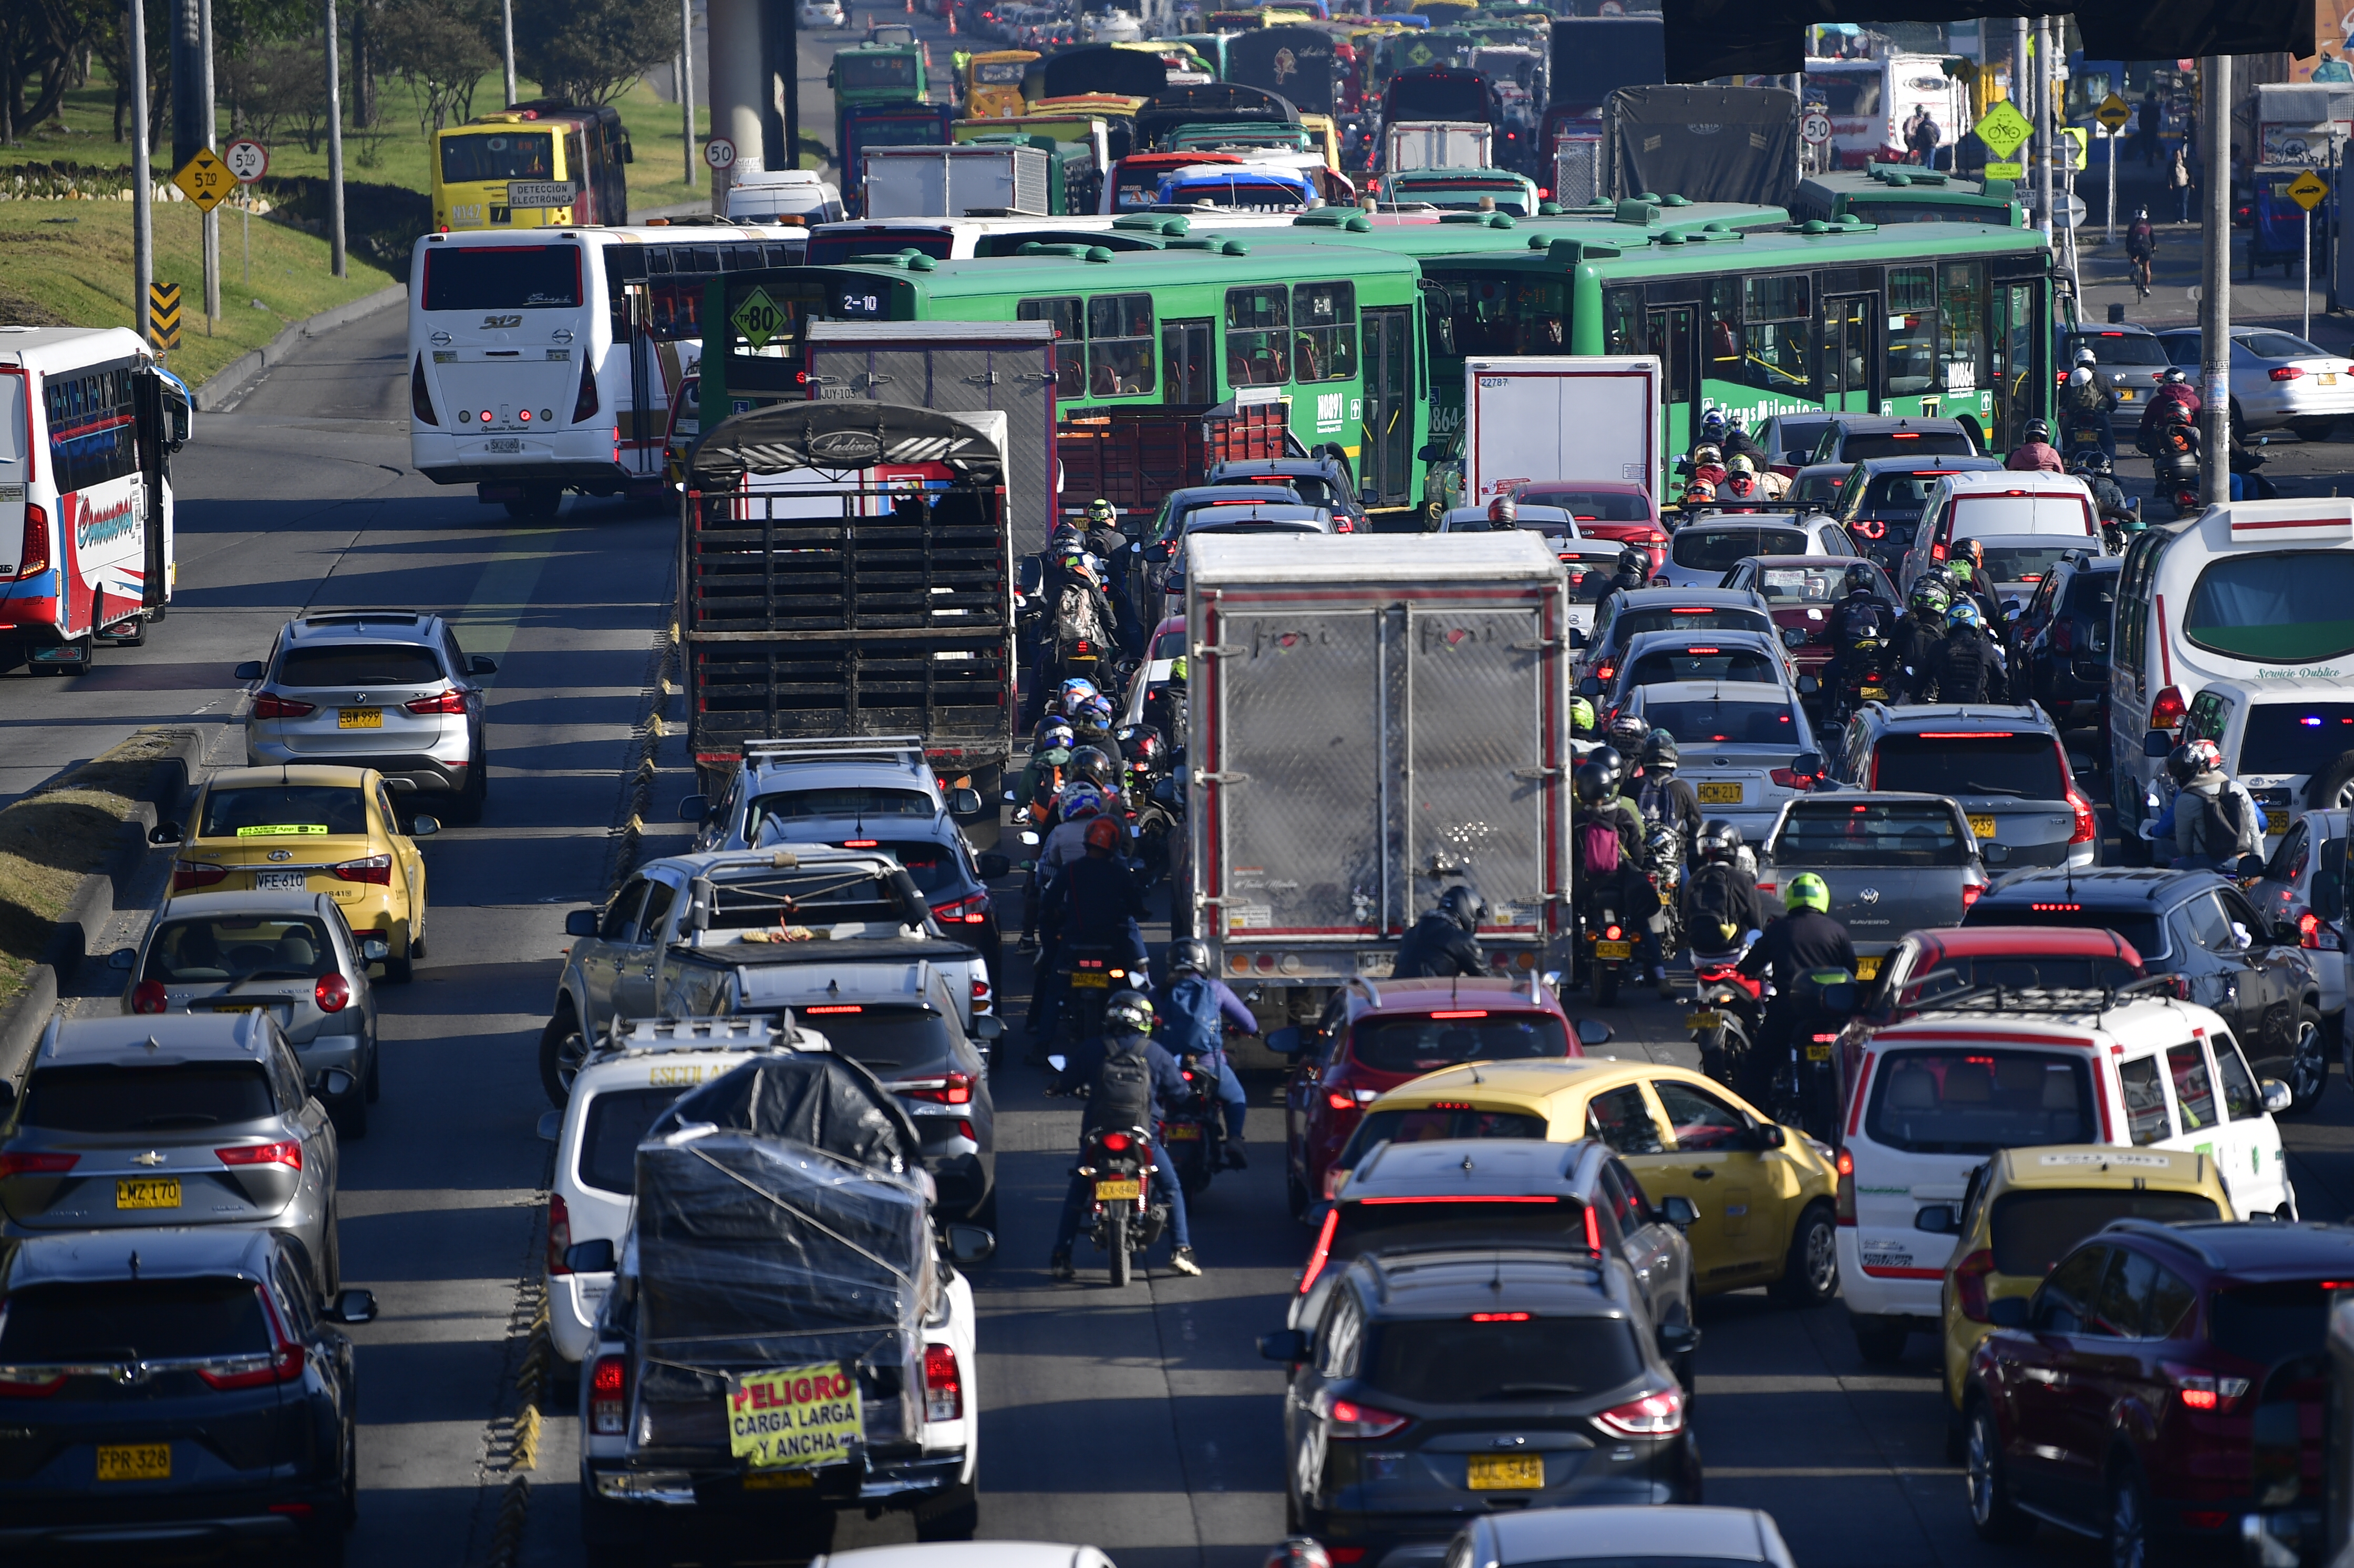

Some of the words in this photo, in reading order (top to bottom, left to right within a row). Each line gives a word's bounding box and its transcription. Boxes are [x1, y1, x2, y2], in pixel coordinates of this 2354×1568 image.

[1807, 120, 1828, 137] 50
[711, 146, 731, 161] 50
[517, 184, 567, 194] DETECCIÓN
[512, 194, 573, 204] ELECTRÓNICA
[844, 295, 876, 311] 2-10
[1314, 298, 1330, 313] 2-10
[1481, 378, 1508, 387] 22787
[1948, 363, 1975, 388] N0864
[1317, 393, 1343, 420] N0891
[2254, 667, 2296, 680] Servicio
[734, 1374, 851, 1412] PELIGRO
[734, 1410, 793, 1437] CARGA
[798, 1402, 856, 1427] LARGA
[758, 1440, 770, 1459] Y
[776, 1433, 837, 1457] ANCHA
